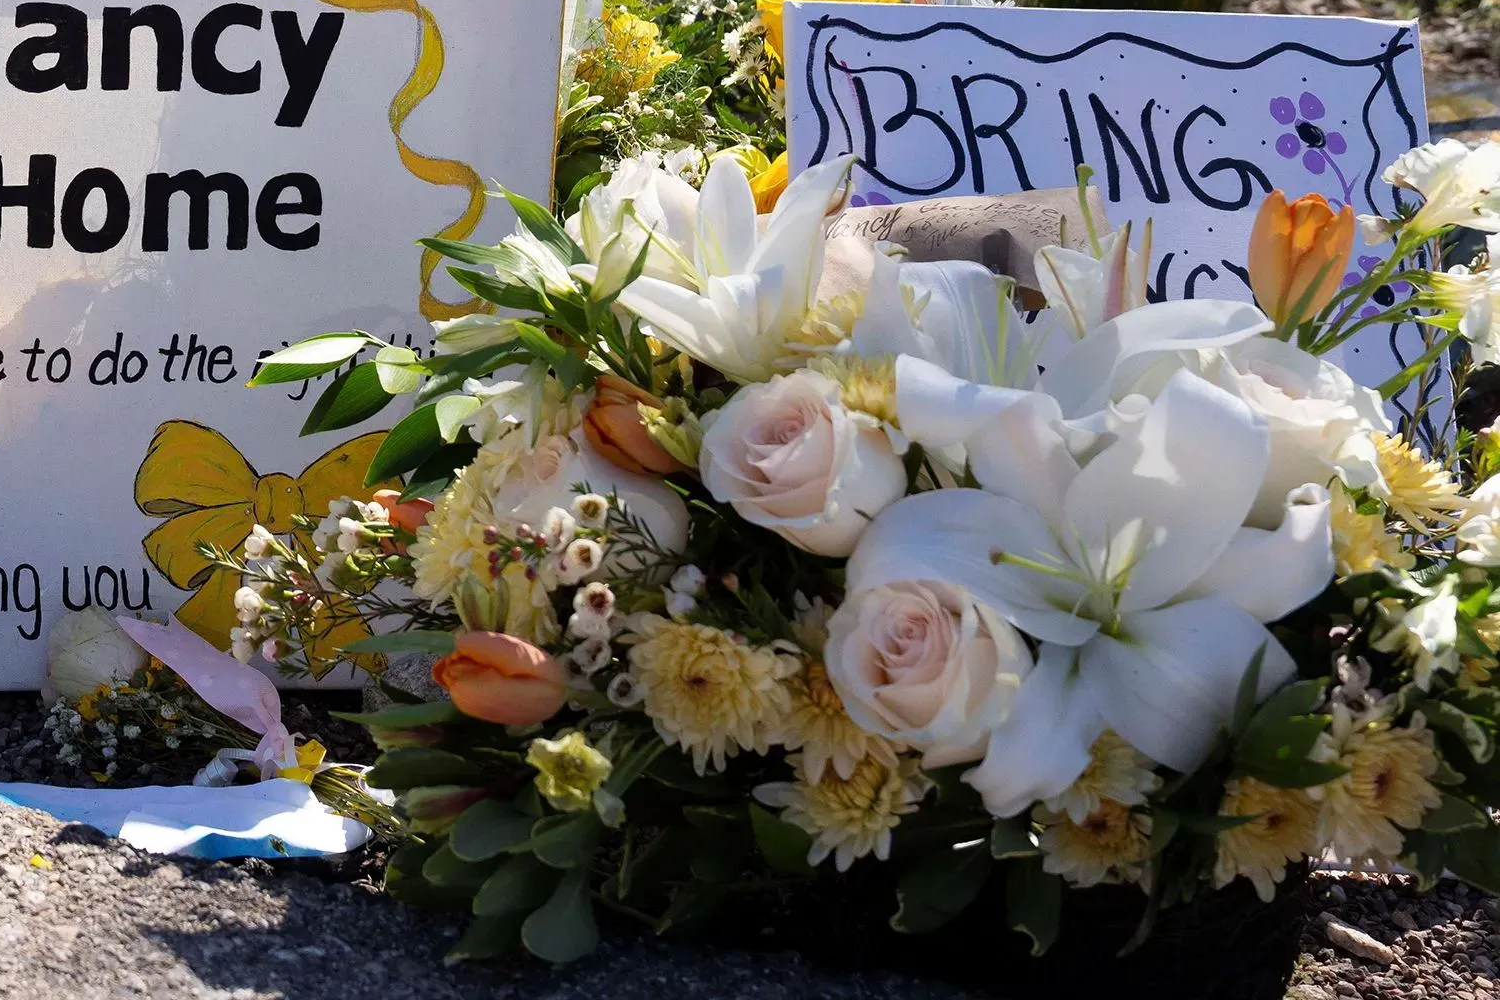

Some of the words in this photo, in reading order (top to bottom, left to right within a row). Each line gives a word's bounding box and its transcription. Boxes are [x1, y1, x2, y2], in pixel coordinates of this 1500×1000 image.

[826, 50, 1274, 212] BRING
[20, 337, 72, 383] to
[88, 332, 149, 385] do
[158, 333, 238, 384] the
[62, 562, 153, 613] you
